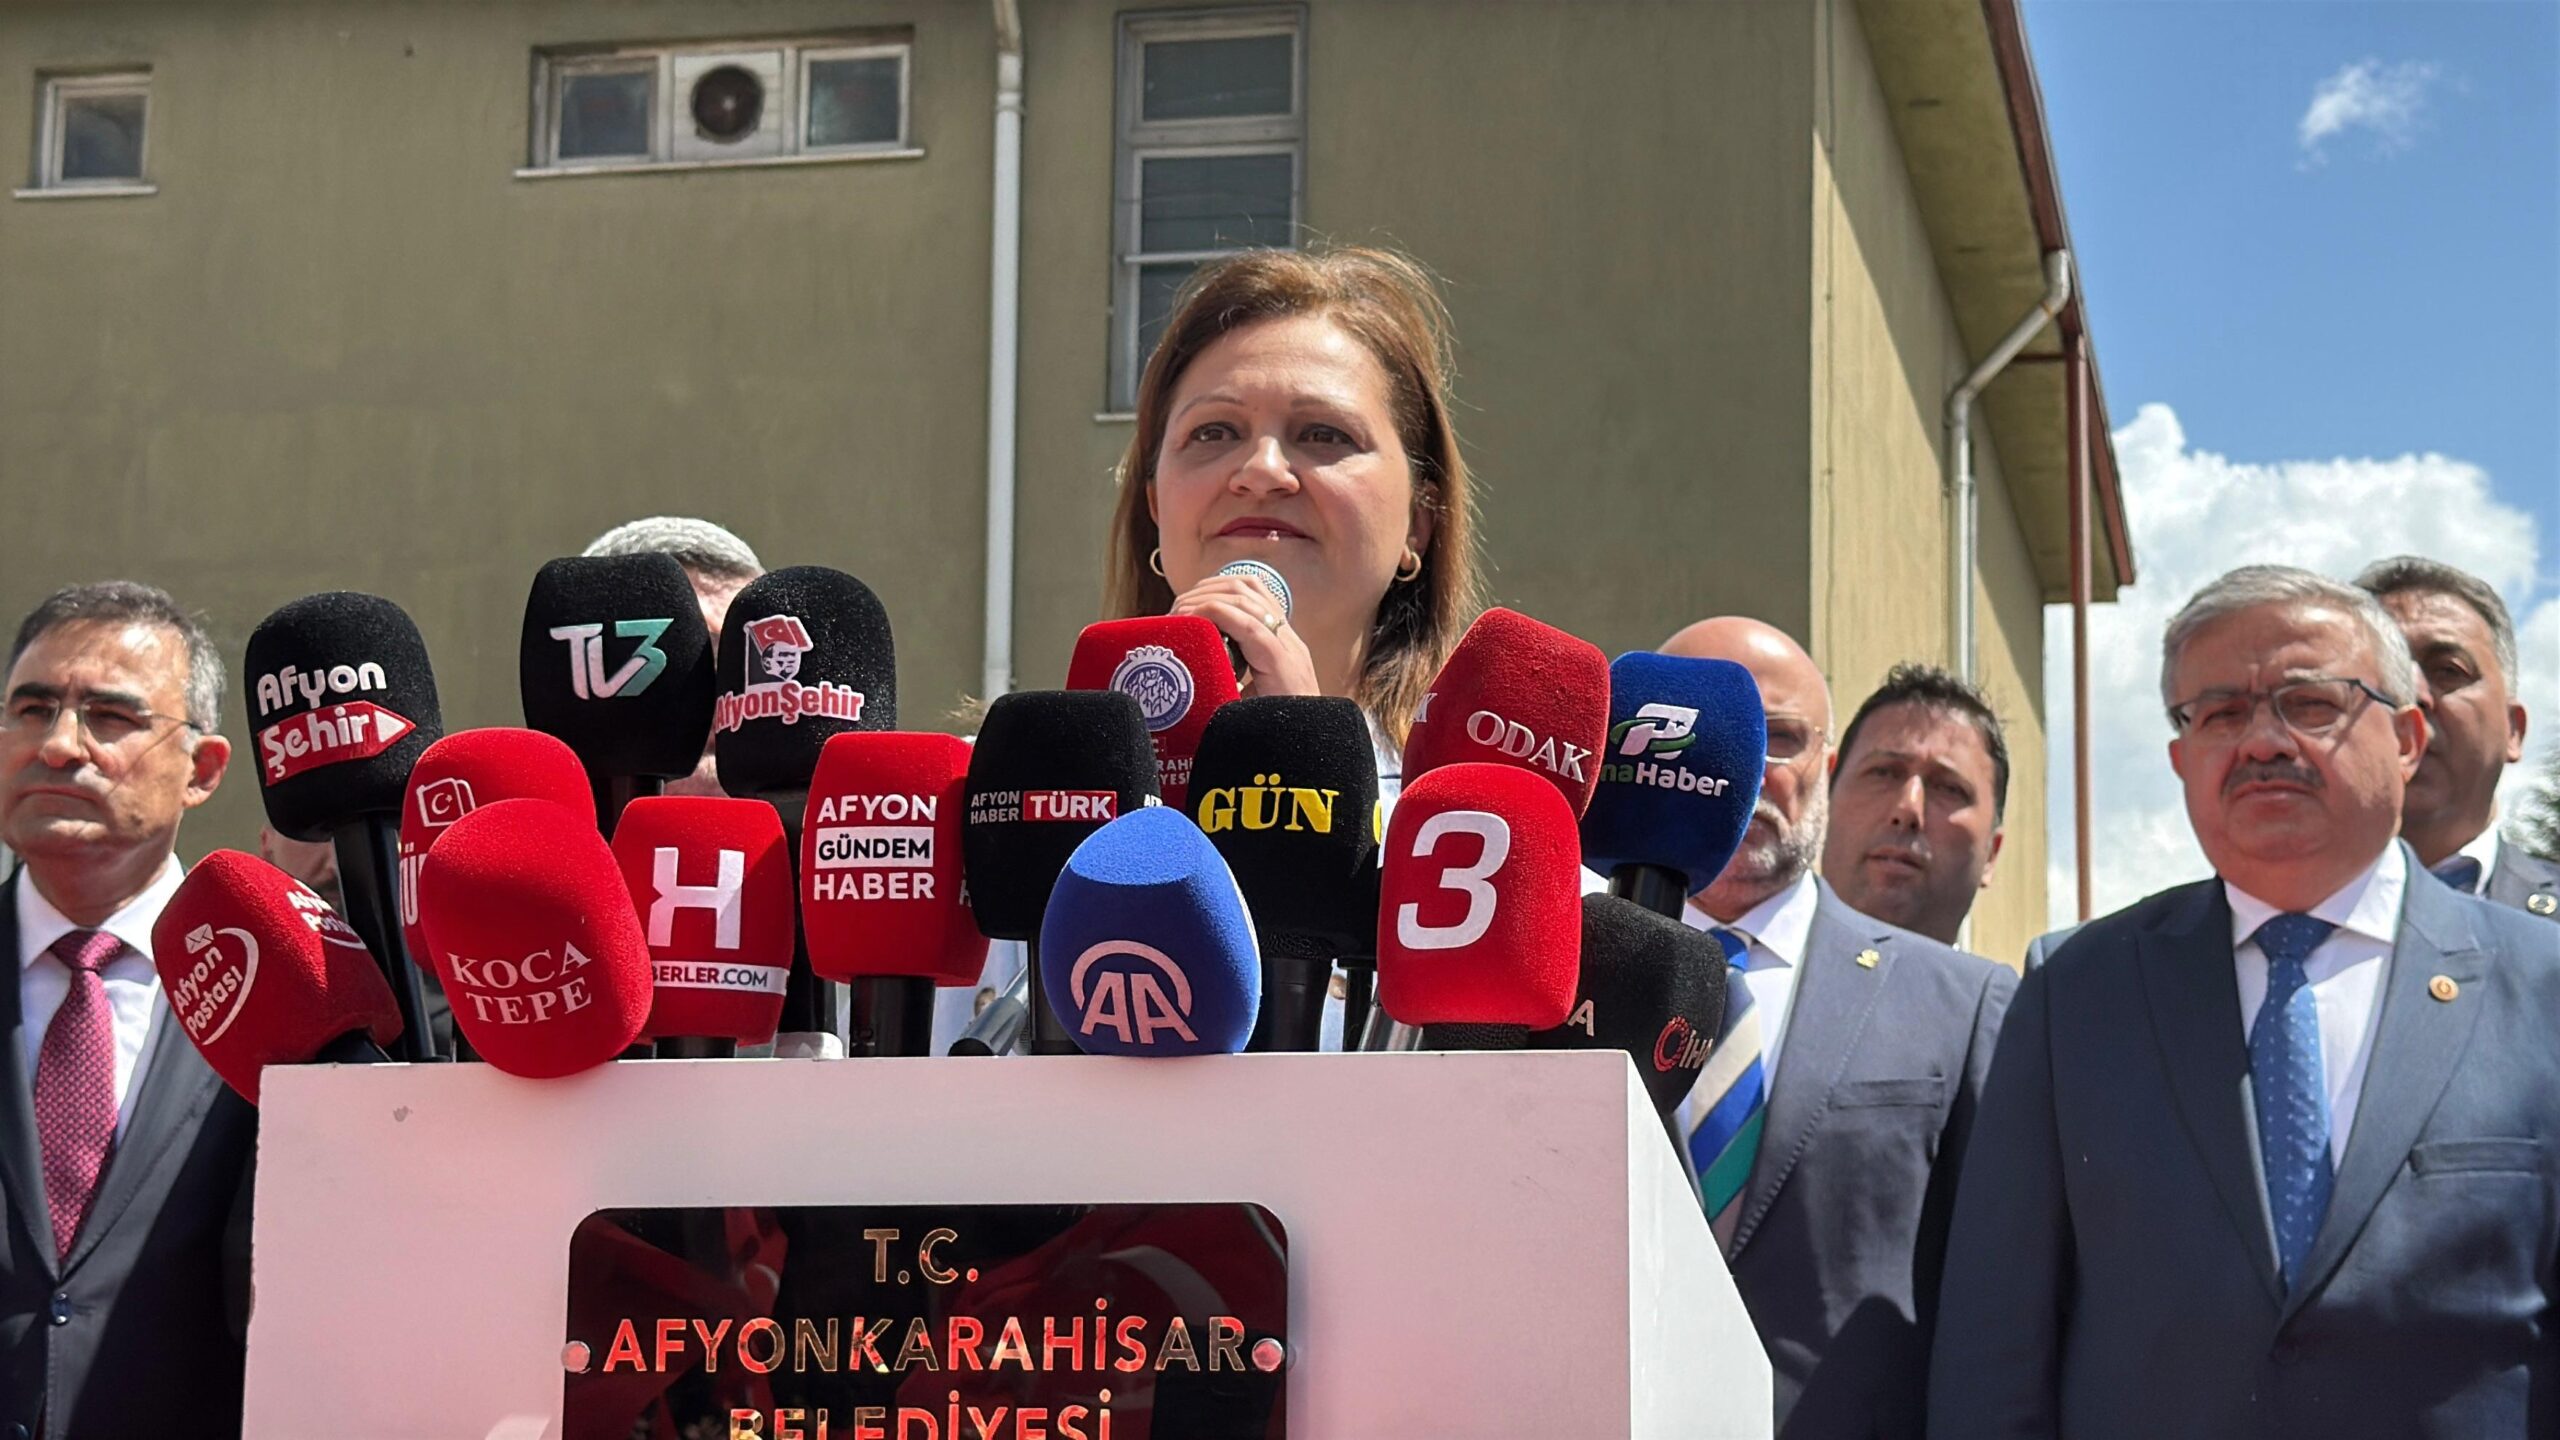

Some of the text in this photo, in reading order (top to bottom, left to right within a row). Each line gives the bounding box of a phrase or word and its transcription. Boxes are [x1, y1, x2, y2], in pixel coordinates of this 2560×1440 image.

[257, 661, 387, 716] Afyon
[716, 681, 862, 731] AfyonŞehir
[263, 706, 370, 778] Şehir
[1467, 710, 1592, 783] ODAK
[817, 794, 937, 823] AFYON
[971, 790, 1020, 807] AFYON
[971, 807, 1019, 825] HABER
[1030, 791, 1112, 819] TÜRK
[1198, 773, 1339, 833] GÜN
[818, 834, 930, 861] GÜNDEM
[813, 871, 935, 901] HABER
[1397, 810, 1511, 950] 3
[173, 946, 223, 1015] Afyon
[447, 941, 591, 989] KOCA
[466, 977, 591, 1025] TEPE
[1080, 970, 1199, 1045] AA
[863, 1228, 979, 1285] T.C.
[602, 1298, 1247, 1374] AFYONKARAHİSAR
